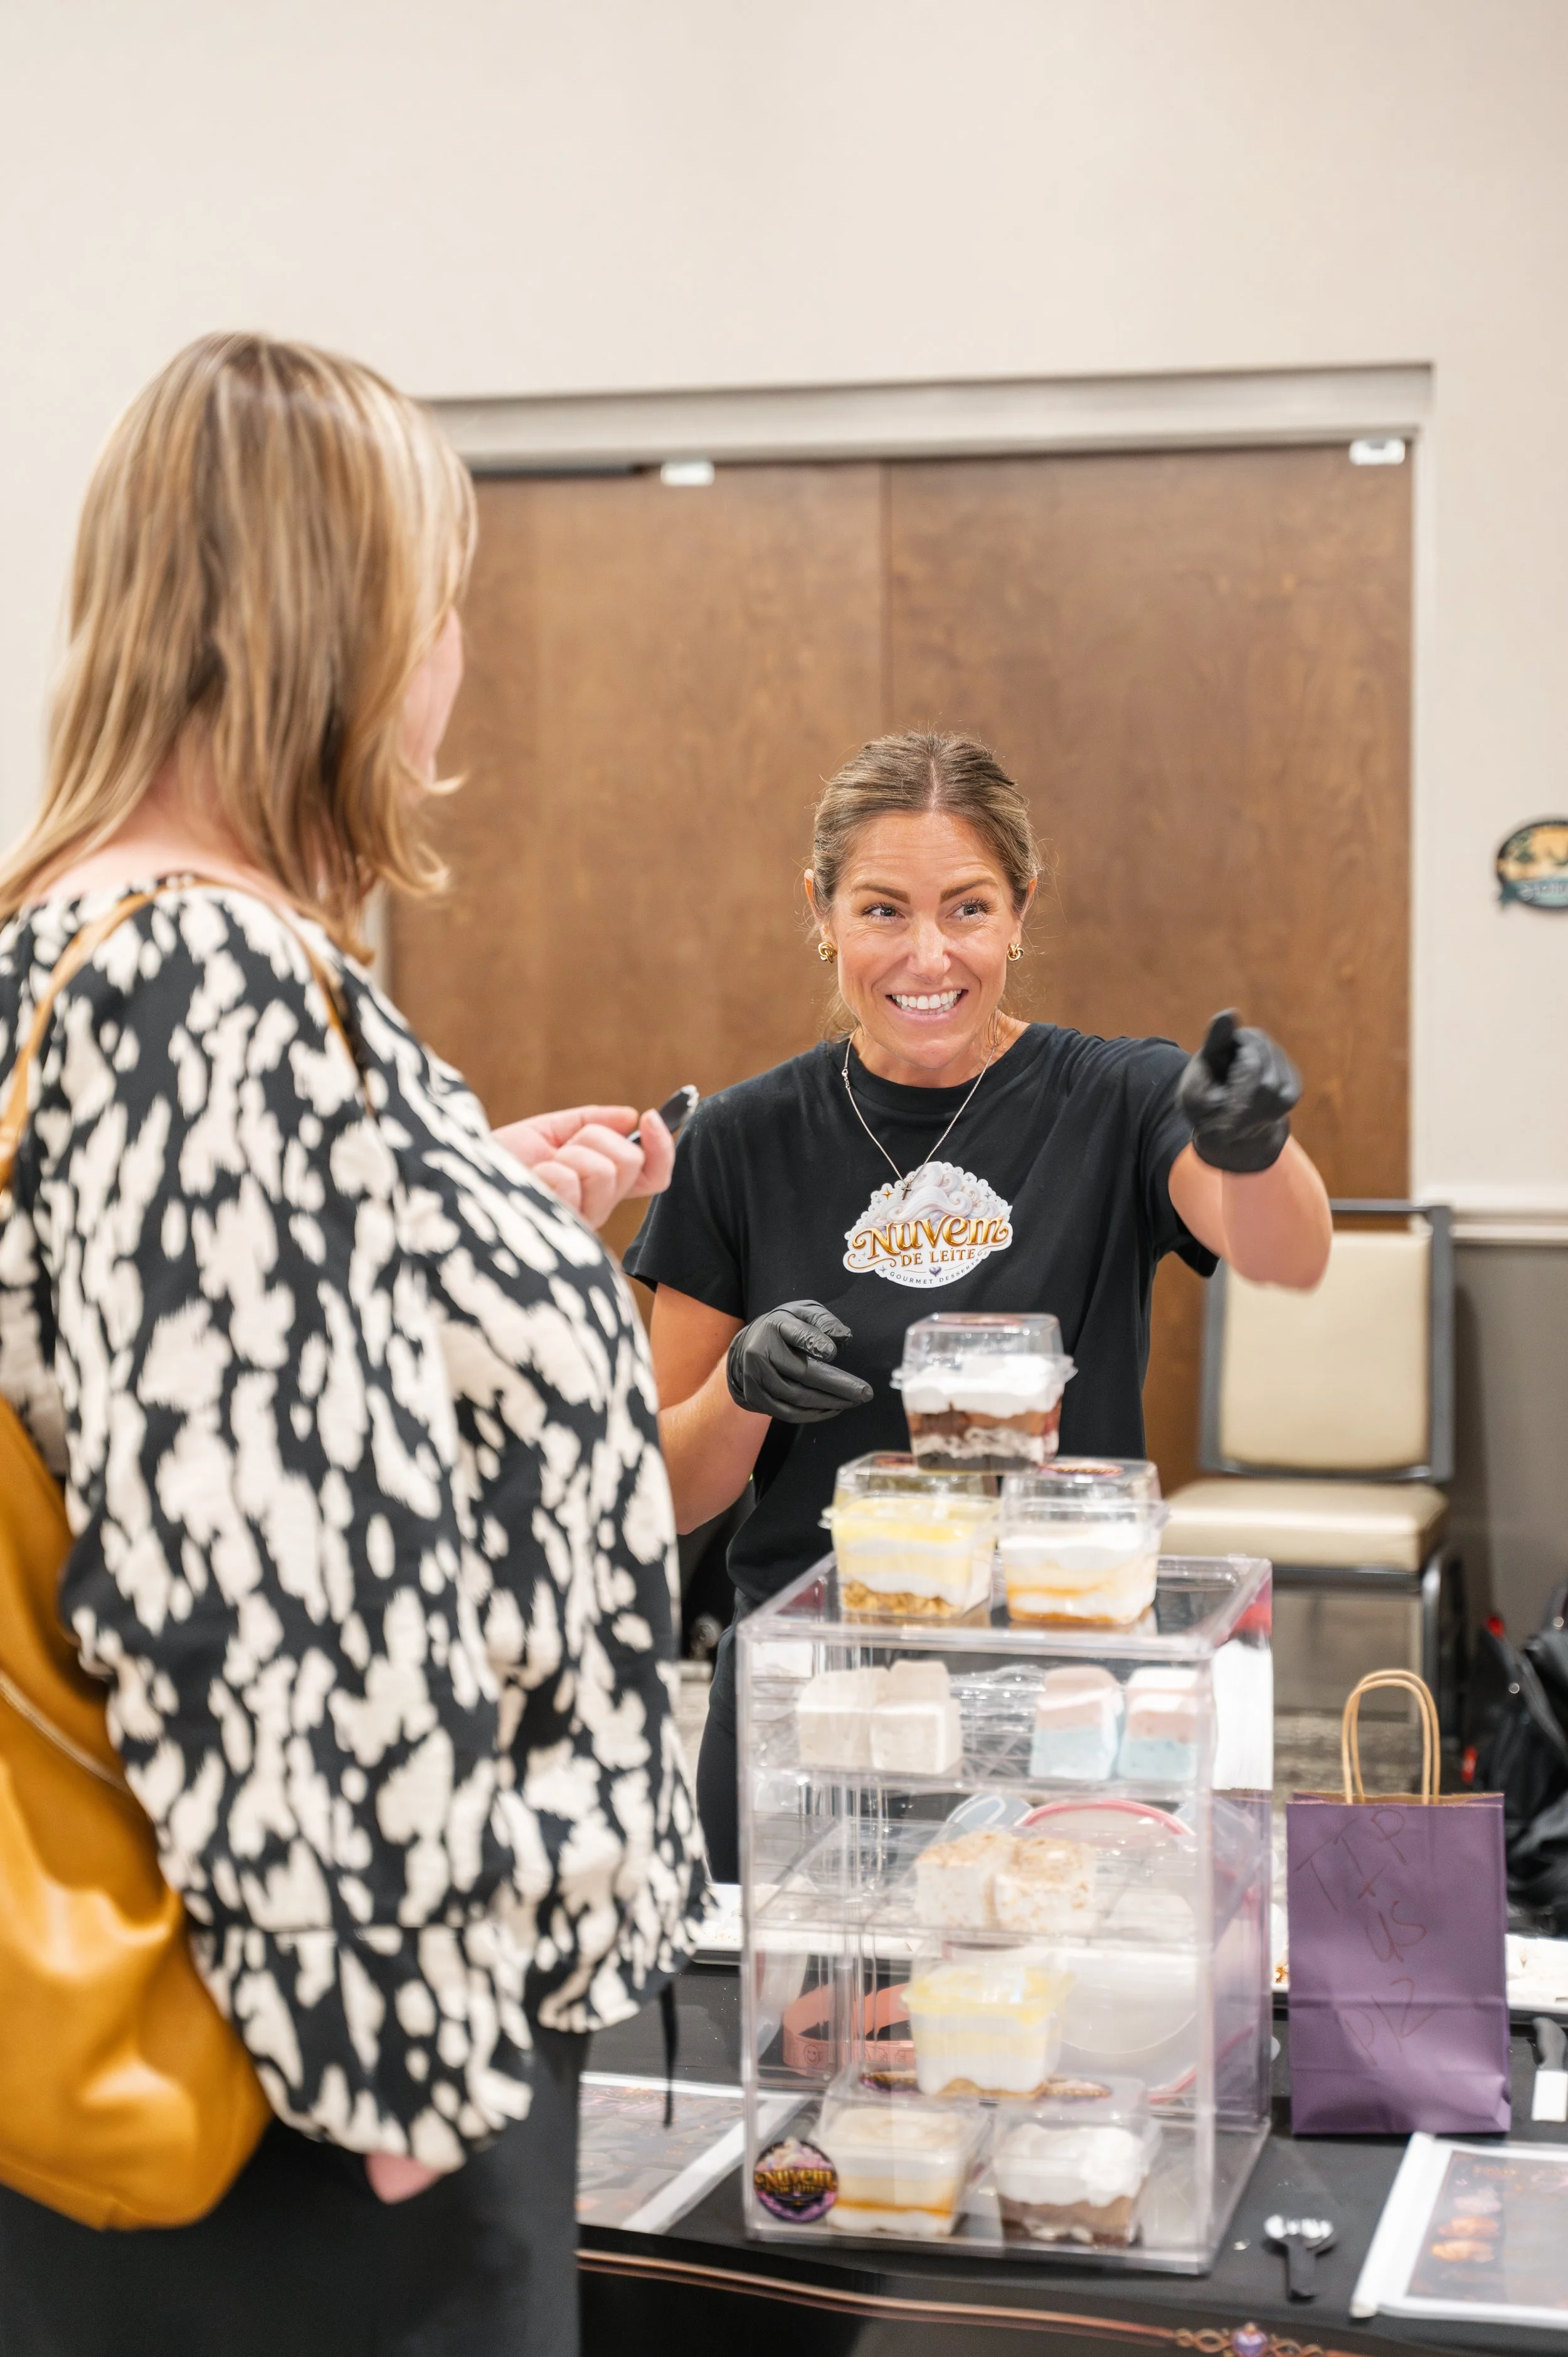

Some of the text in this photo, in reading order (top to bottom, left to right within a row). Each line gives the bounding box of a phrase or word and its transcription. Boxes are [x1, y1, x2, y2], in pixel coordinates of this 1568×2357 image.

[852, 1214, 1009, 1260] Nuvem
[889, 1258, 980, 1284] GOURMET DESSERTS
[900, 1253, 923, 1267] DE
[1295, 1809, 1407, 1912] TIP
